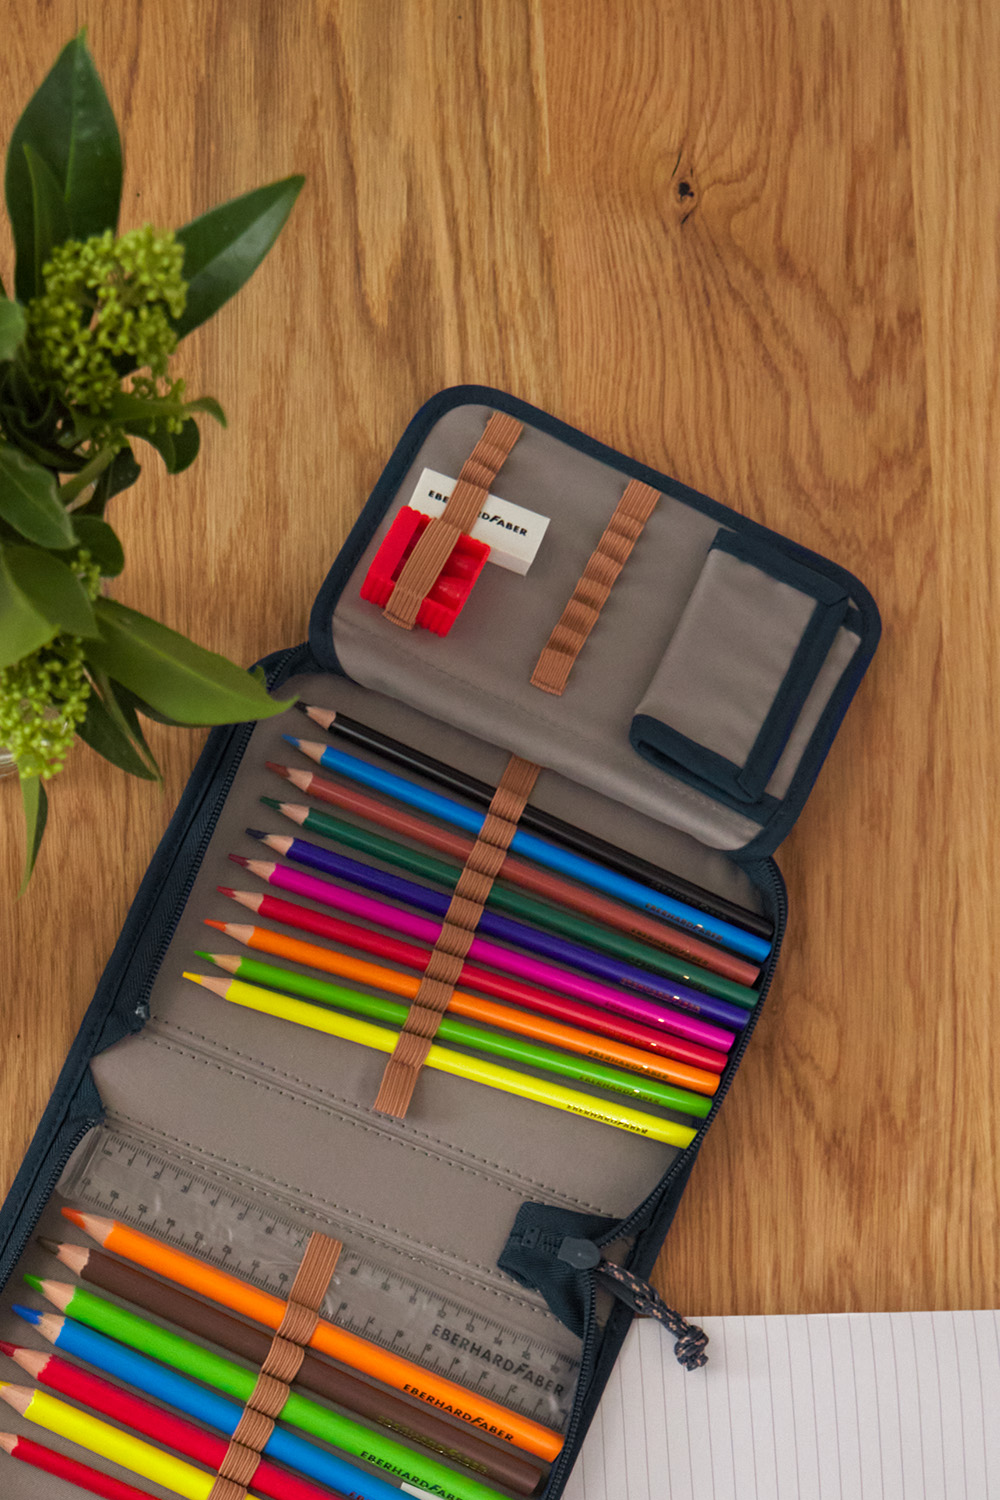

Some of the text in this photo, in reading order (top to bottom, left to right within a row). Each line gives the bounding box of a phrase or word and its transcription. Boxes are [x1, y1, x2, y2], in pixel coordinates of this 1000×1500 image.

[428, 489, 528, 536] EBEDFABER
[432, 1324, 565, 1396] EBERHARDFABER
[402, 1383, 514, 1441] EBERHARDFABER
